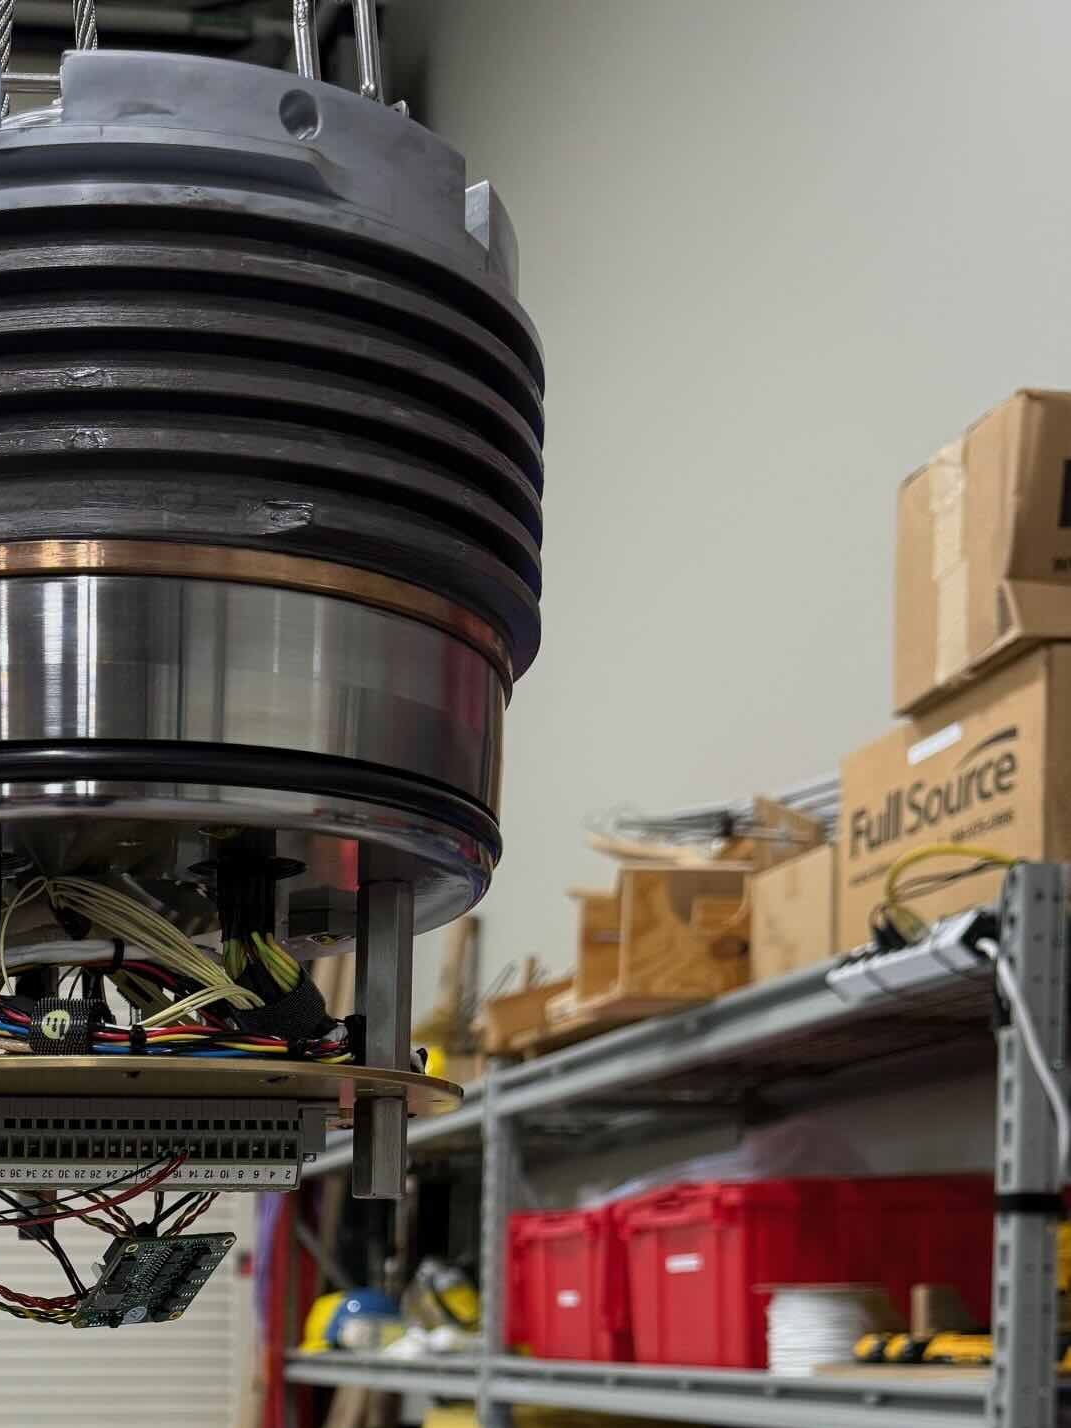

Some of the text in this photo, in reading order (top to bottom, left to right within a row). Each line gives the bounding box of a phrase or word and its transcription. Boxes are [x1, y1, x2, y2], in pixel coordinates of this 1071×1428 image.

[849, 788, 903, 859] Full
[905, 751, 1016, 834] Source
[10, 1168, 22, 1178] 36
[26, 1169, 37, 1178] 34
[42, 1169, 54, 1178] 32
[58, 1169, 70, 1179] 30
[74, 1169, 86, 1179] 28
[90, 1169, 102, 1179] 26
[107, 1169, 118, 1179] 24
[189, 1169, 198, 1178] 14
[204, 1169, 214, 1179] 12
[219, 1169, 229, 1179] 10
[237, 1169, 245, 1179] 8
[253, 1169, 260, 1179] 6
[284, 1169, 291, 1179] 2
